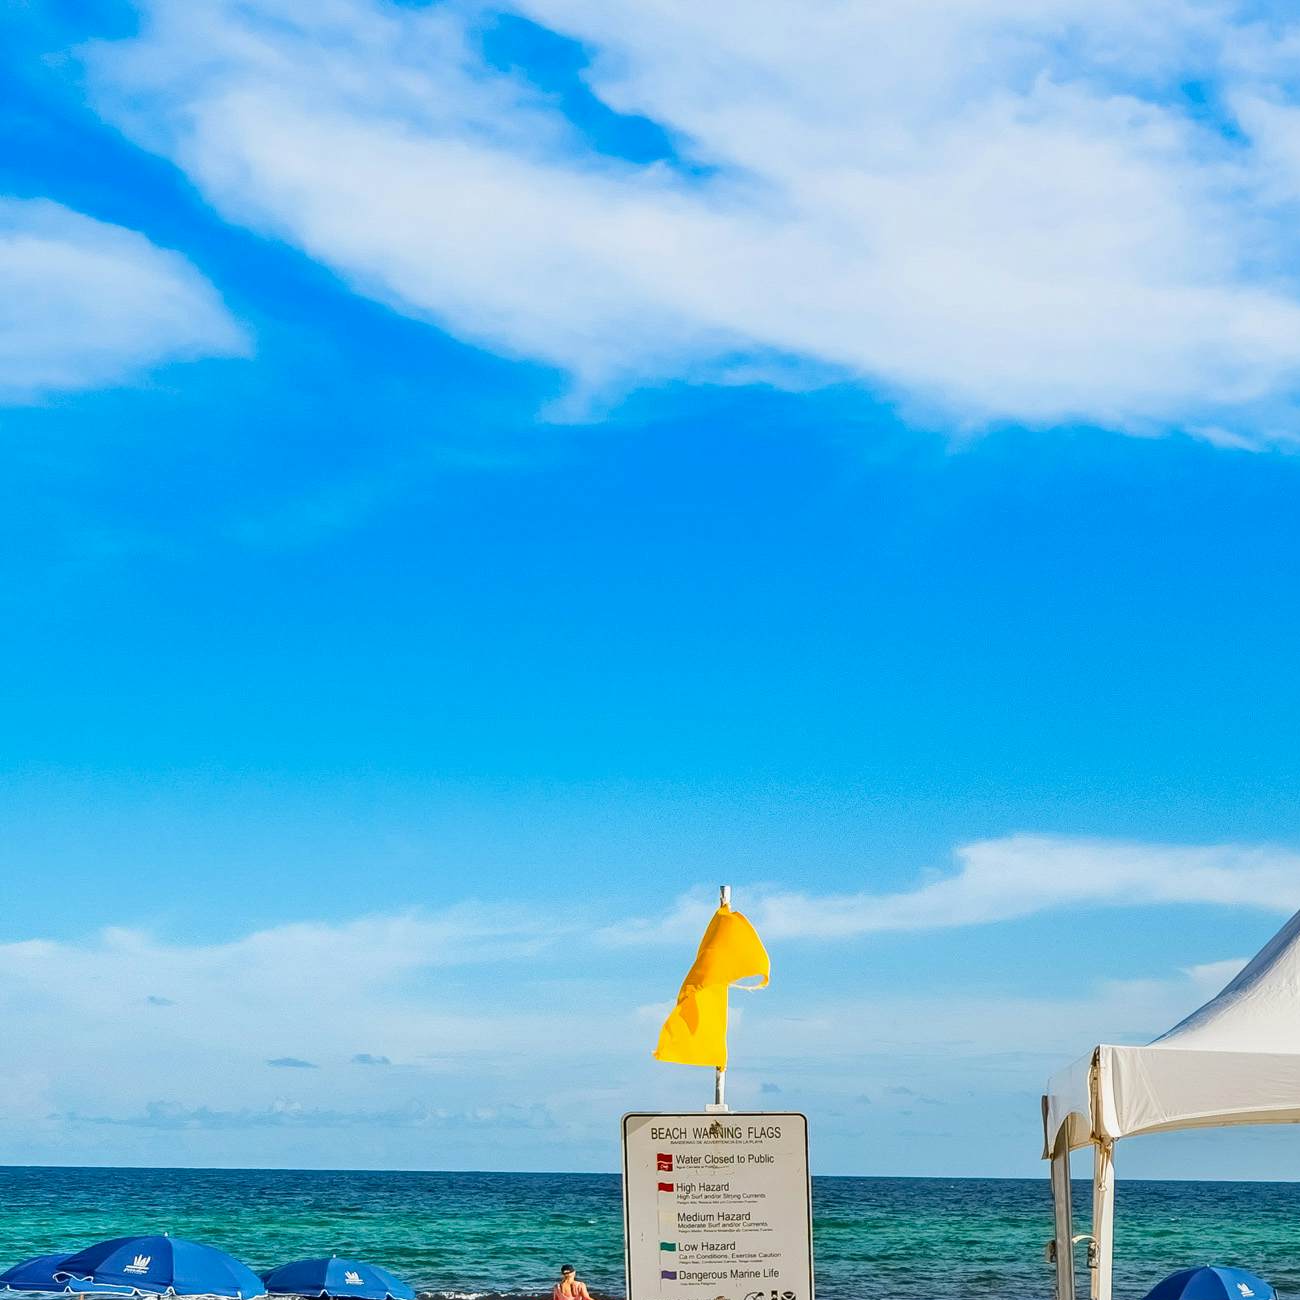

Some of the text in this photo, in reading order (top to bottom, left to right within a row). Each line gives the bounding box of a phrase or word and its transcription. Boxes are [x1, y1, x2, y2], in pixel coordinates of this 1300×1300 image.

[651, 1126, 782, 1140] BEACH WARNING FLAGS
[675, 1153, 775, 1165] Water Closed to Public
[676, 1182, 730, 1195] High Hazard
[677, 1212, 751, 1222] Medium Hazard
[678, 1241, 736, 1252] Low Hazard
[679, 1268, 780, 1282] Dangerous Marine Life
